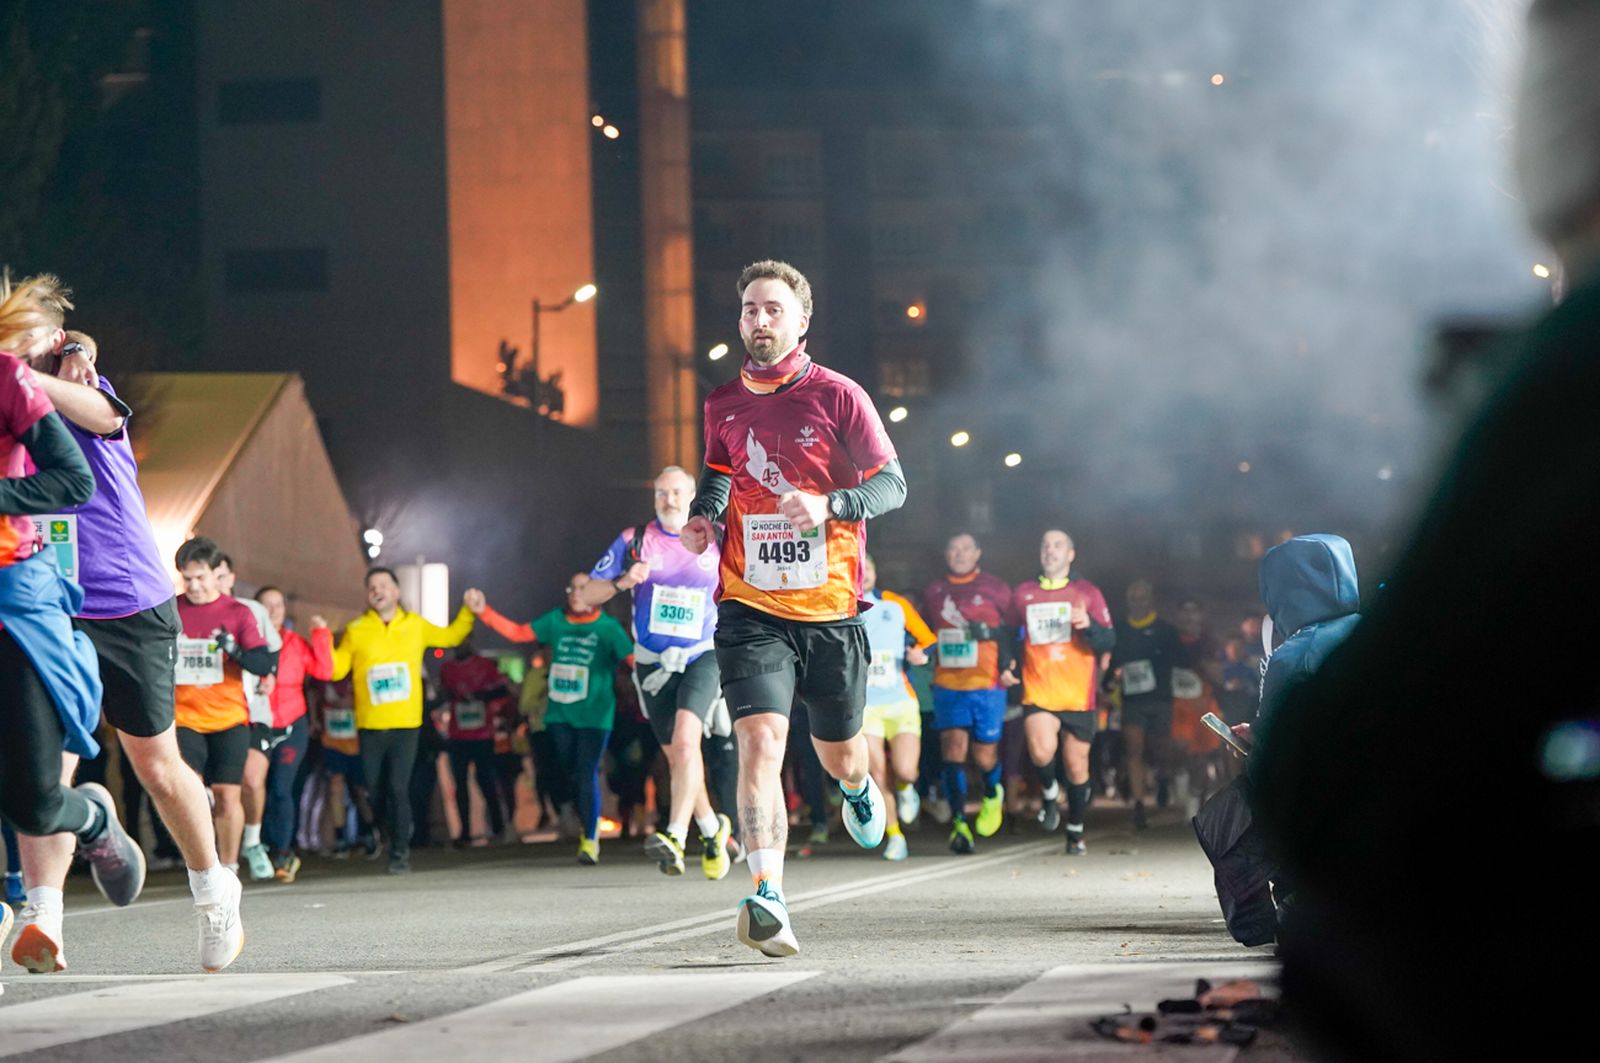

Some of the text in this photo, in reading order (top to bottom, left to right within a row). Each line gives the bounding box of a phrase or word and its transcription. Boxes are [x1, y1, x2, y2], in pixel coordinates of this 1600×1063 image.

[762, 468, 779, 486] 43
[759, 522, 793, 531] NOCHE DE
[751, 532, 766, 541] SAN
[759, 540, 811, 564] 4493
[660, 604, 694, 621] 3305
[183, 656, 212, 669] 7088
